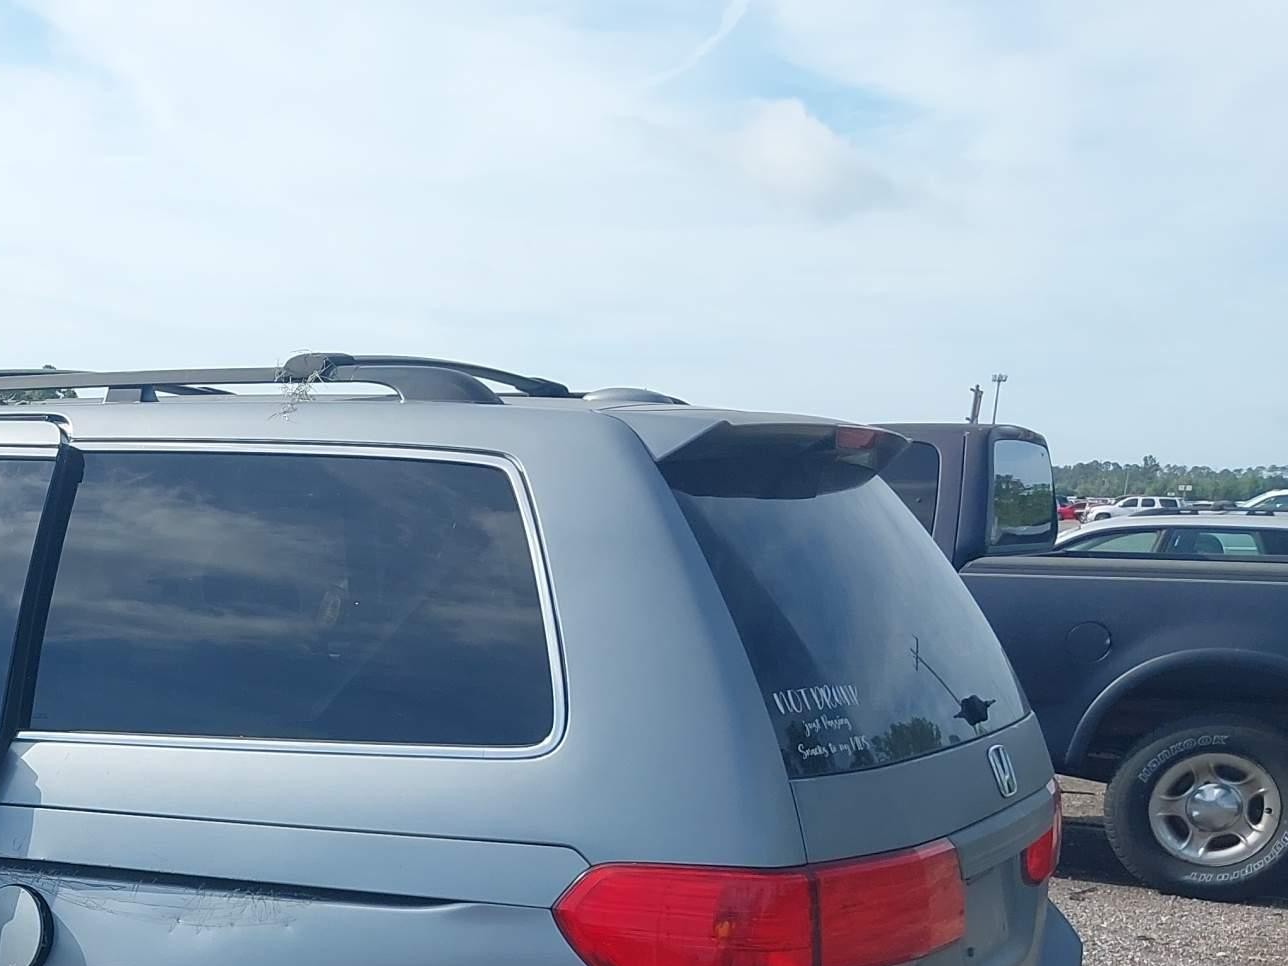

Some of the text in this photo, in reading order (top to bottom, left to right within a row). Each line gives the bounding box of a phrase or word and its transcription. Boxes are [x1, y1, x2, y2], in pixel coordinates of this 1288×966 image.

[773, 688, 811, 714] NOT
[802, 718, 821, 737] just
[828, 743, 837, 754] to
[838, 743, 852, 756] my
